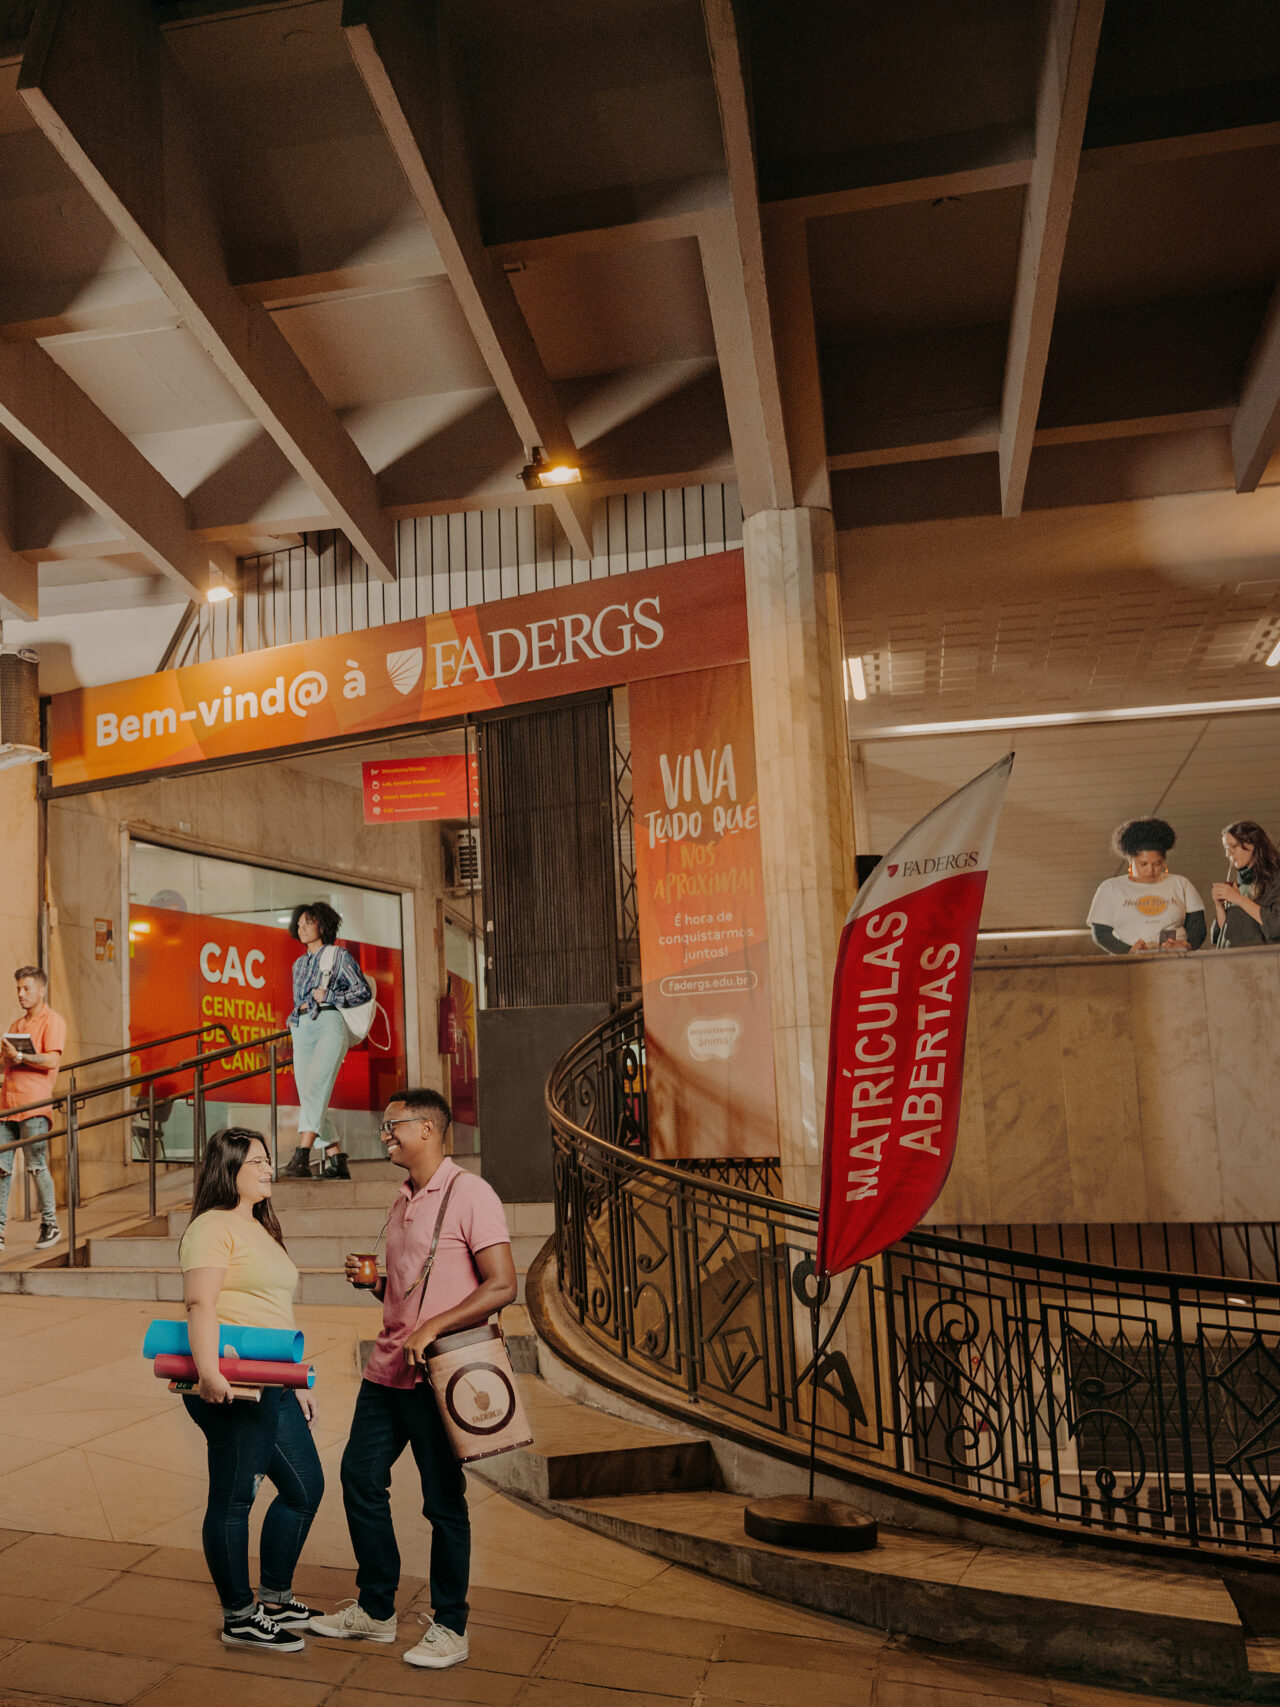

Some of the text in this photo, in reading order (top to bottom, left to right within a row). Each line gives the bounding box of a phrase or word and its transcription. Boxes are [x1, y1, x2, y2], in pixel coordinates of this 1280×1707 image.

[96, 596, 664, 747] Bem-vind@ à FADERGS
[659, 744, 737, 809] VIVA
[644, 804, 758, 849] TUDO QUE
[681, 840, 716, 869] NOS
[902, 851, 979, 877] FADERGS
[684, 914, 713, 925] hora
[716, 910, 733, 922] de
[659, 928, 754, 945] conquistarmos
[683, 946, 728, 964] juntos!
[199, 942, 266, 988] CAC
[202, 995, 276, 1022] CENTRAL
[842, 911, 909, 1202] MATRÍCULAS
[899, 942, 961, 1157] ABERTAS
